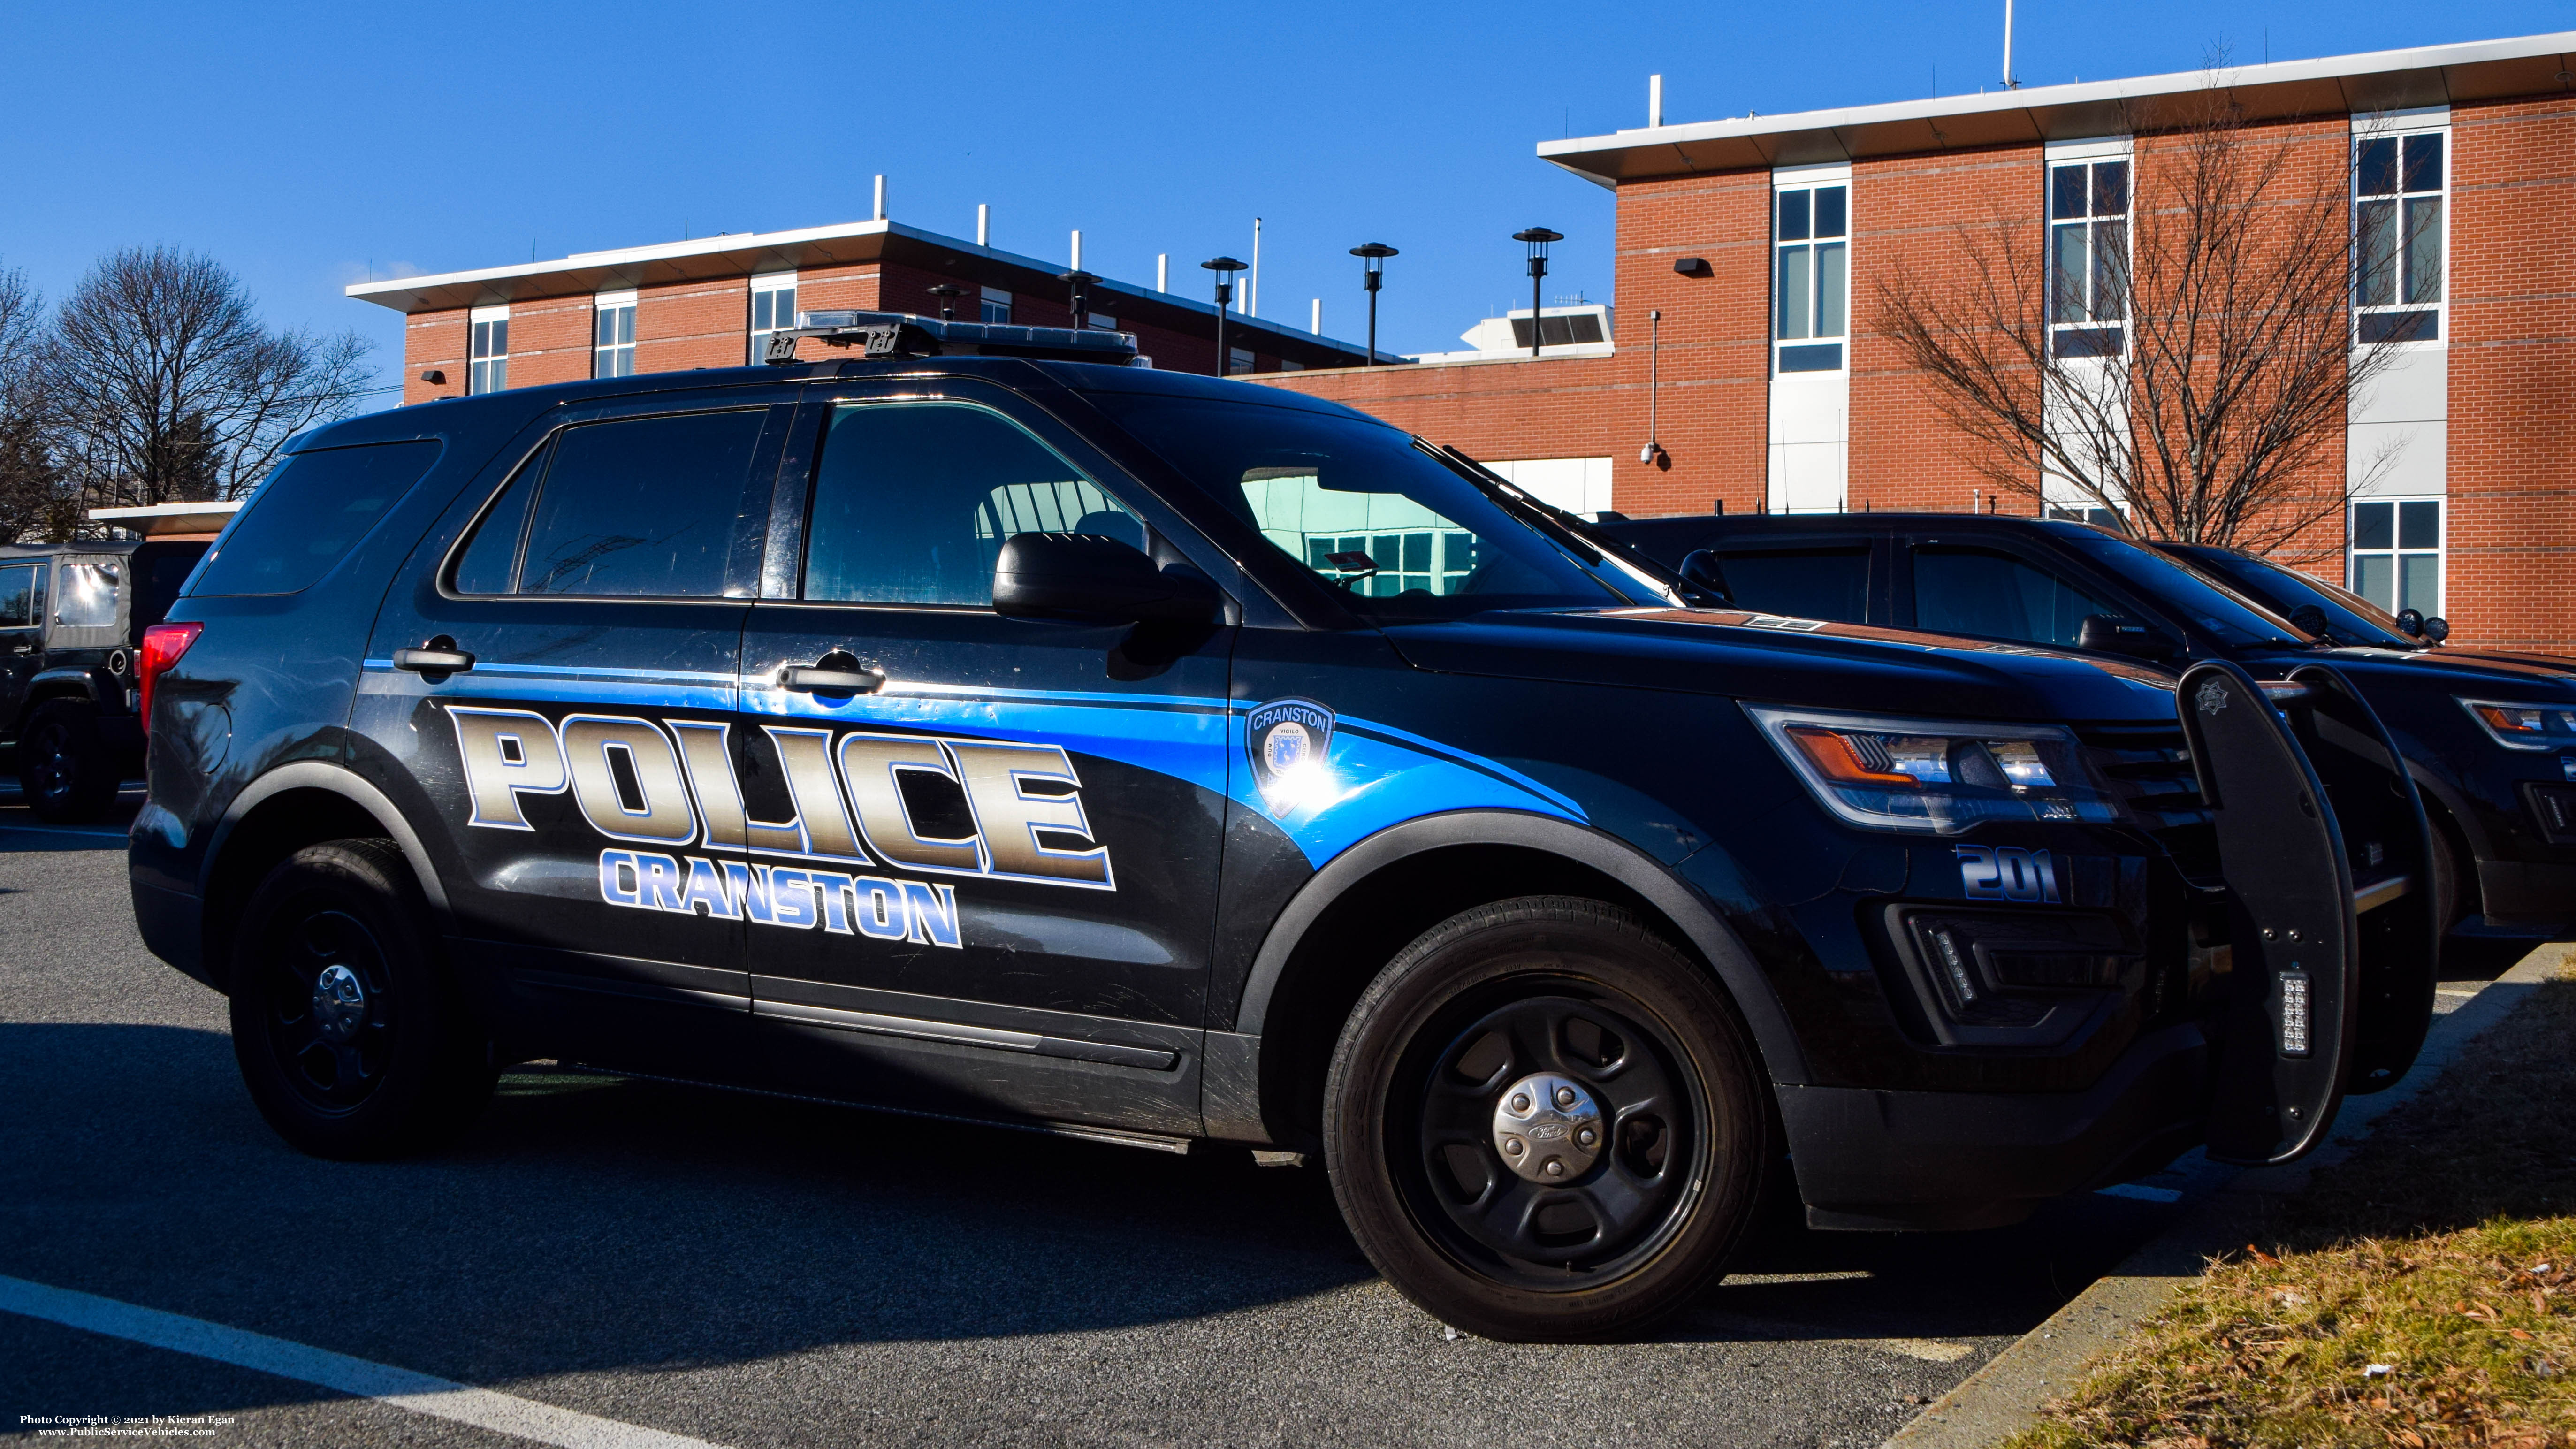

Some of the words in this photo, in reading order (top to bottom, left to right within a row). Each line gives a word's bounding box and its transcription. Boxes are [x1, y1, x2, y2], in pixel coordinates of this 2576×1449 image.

[1254, 707, 1326, 732] CRANSTON
[443, 705, 1117, 892] POLICE
[599, 848, 963, 948] CRANSTON
[1956, 844, 2062, 903] 201
[1537, 1126, 1561, 1138] Ford
